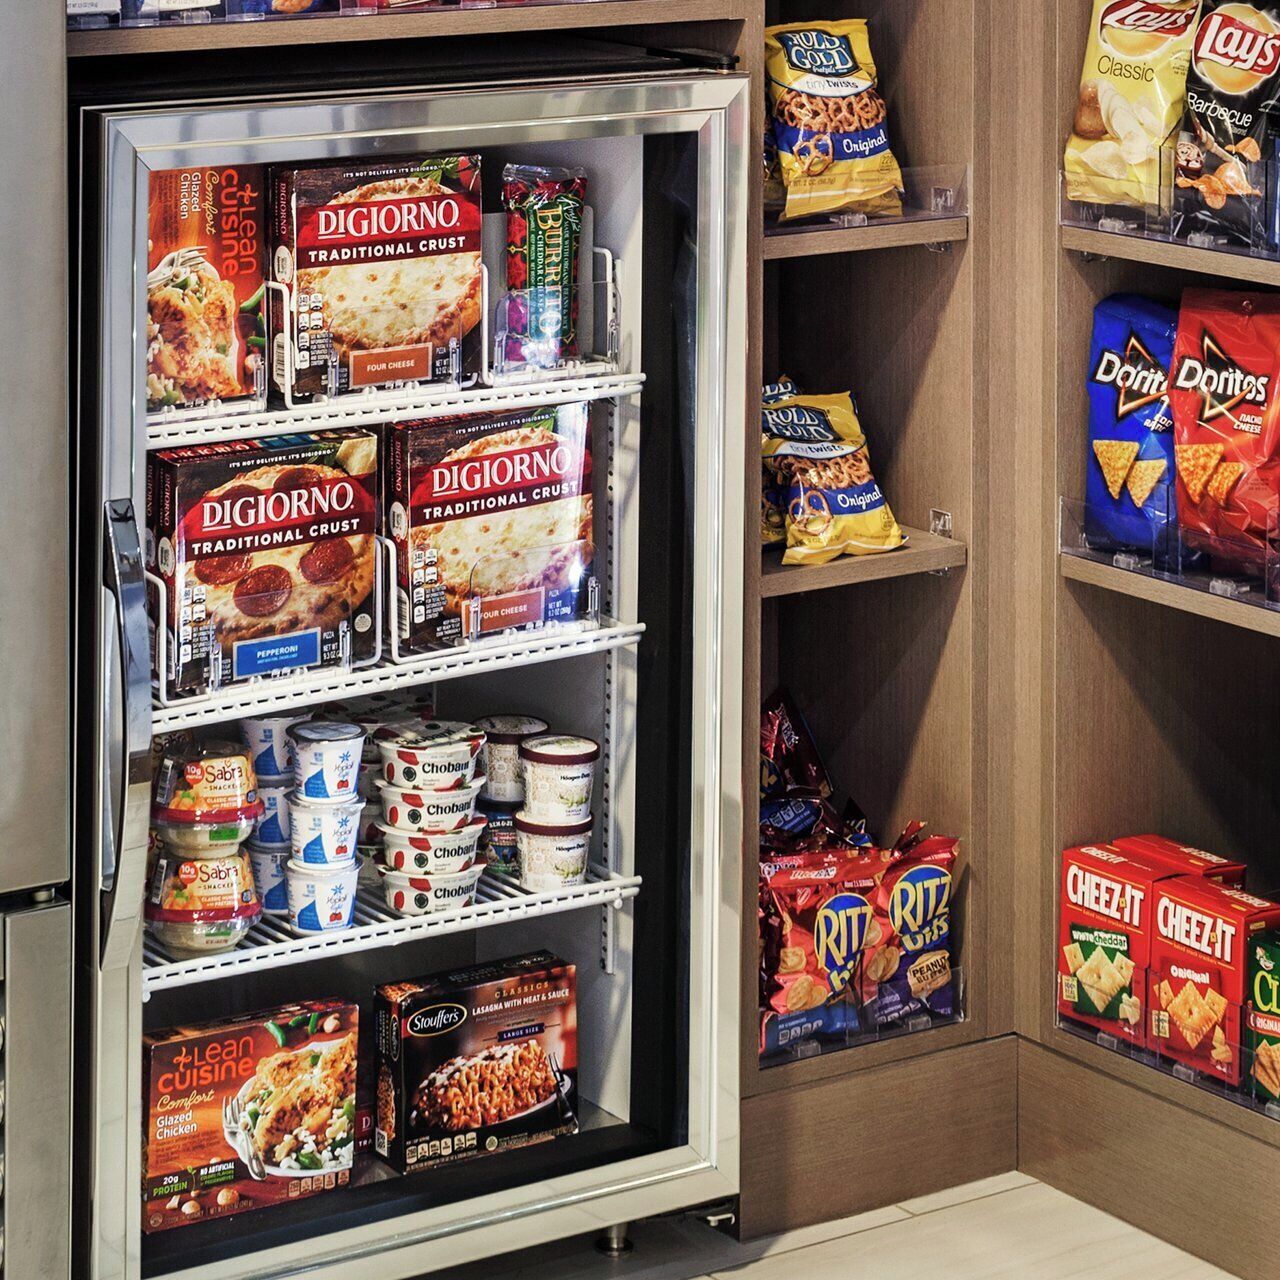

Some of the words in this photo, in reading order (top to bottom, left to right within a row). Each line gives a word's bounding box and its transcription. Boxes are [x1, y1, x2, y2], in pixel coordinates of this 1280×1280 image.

[791, 46, 854, 69] GOLD
[1097, 55, 1155, 83] Classic
[1187, 91, 1253, 128] Barbecue
[843, 129, 887, 155] Original
[181, 173, 190, 219] Chicken
[191, 172, 201, 212] Glazed
[202, 171, 219, 235] Comfort
[309, 243, 414, 263] TRADITIONAL
[419, 236, 466, 252] CRUST
[367, 363, 387, 371] FOUR
[388, 359, 415, 370] CHEESE
[1177, 358, 1269, 402] Doritos
[1233, 421, 1262, 435] CHEESE
[1239, 413, 1263, 425] NACHO
[423, 492, 527, 519] TRADITIONAL
[533, 481, 578, 500] CRUST
[837, 485, 882, 509] Original
[192, 528, 303, 555] TRADITIONAL
[309, 518, 360, 537] CRUST
[501, 604, 527, 616] CHEESE
[257, 645, 298, 659] PEPPERONI
[205, 764, 243, 783] Sabra
[199, 864, 238, 883] Sabra
[893, 876, 952, 923] RITZ
[818, 906, 872, 963] RITZ
[912, 954, 948, 977] PEANUT
[472, 1004, 503, 1015] LASAGNA
[504, 999, 522, 1009] WITH
[523, 995, 540, 1005] MEAT
[548, 989, 570, 1000] SAUCE
[495, 982, 550, 999] CLASSICS
[414, 1009, 459, 1031] Stouffer's
[156, 1089, 215, 1113] Comfort
[156, 1110, 192, 1128] Glazed
[156, 1123, 197, 1140] Chicken
[154, 1182, 187, 1196] PROTEIN
